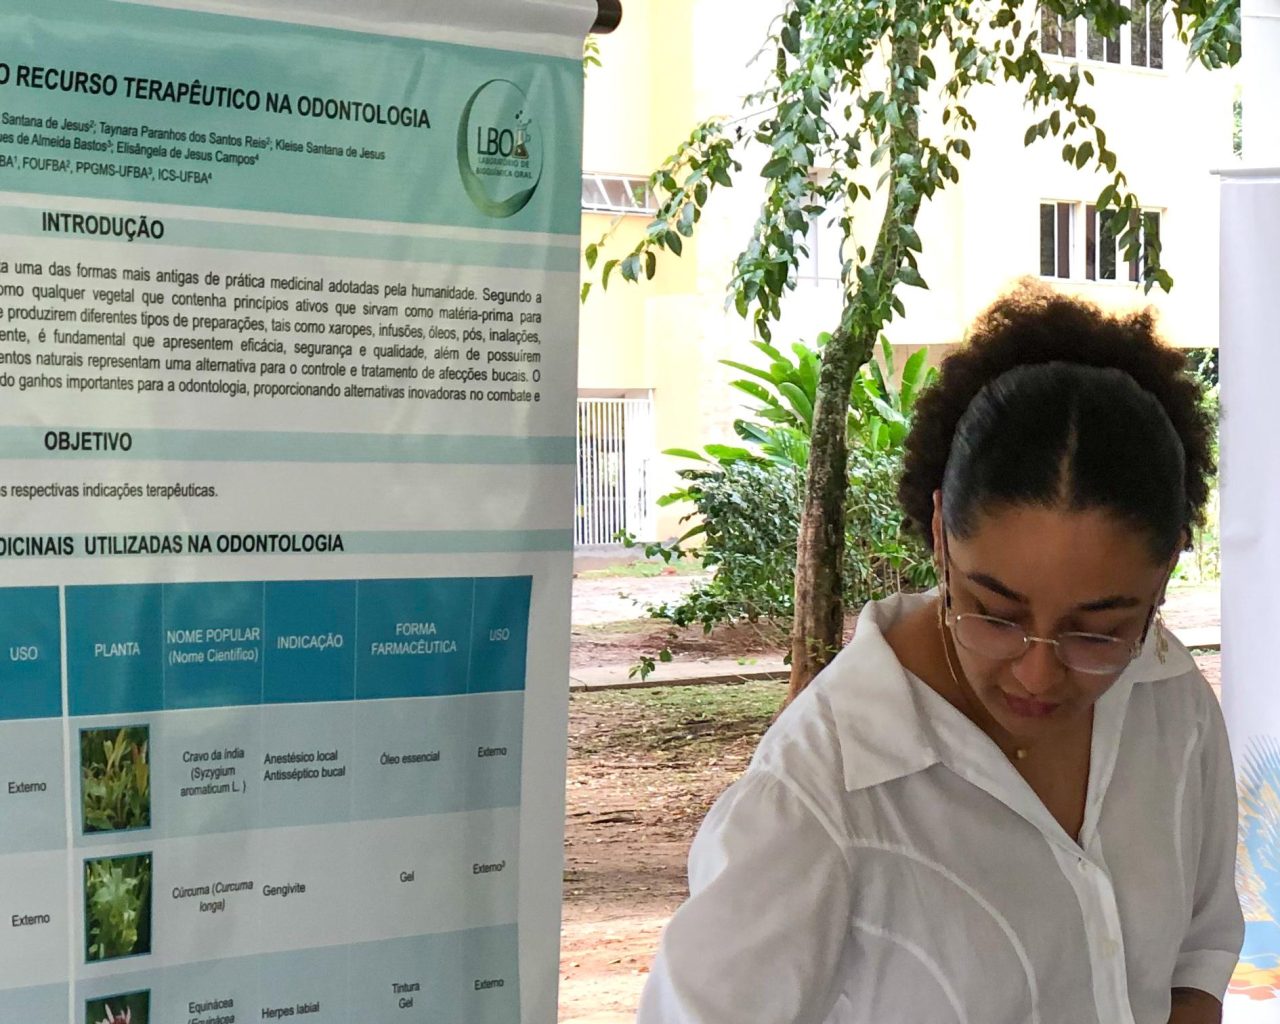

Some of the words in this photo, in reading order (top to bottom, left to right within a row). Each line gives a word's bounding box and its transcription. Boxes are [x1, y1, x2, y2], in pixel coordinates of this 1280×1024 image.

[16, 65, 117, 96] RECURSO
[124, 76, 260, 111] TERAPÊUTICO
[265, 92, 292, 114] NA
[297, 95, 431, 129] ODONTOLOGIA
[2, 112, 43, 129] Santana
[45, 116, 58, 129] de
[100, 121, 138, 137] Taynara
[140, 125, 187, 142] Paranhos
[188, 130, 206, 143] dos
[208, 132, 242, 147] Santos
[275, 138, 304, 152] Kleise
[306, 141, 344, 156] Santana
[345, 146, 357, 158] de
[359, 147, 385, 160] Jesus
[478, 126, 514, 157] LBO
[16, 132, 30, 145] de
[30, 133, 71, 149] Almeida
[116, 141, 167, 159] Elisângela
[169, 146, 182, 159] de
[184, 147, 213, 161] Jesus
[42, 212, 164, 242] INTRODUÇÃO
[14, 263, 42, 275] uma
[48, 261, 71, 277] das
[76, 262, 117, 279] formas
[122, 266, 150, 282] mais
[155, 269, 199, 287] antigas
[204, 271, 220, 286] de
[225, 273, 265, 289] prática
[270, 276, 323, 291] medicinal
[328, 279, 379, 295] adotadas
[384, 283, 406, 298] pela
[411, 283, 476, 300] humanidade.
[482, 287, 532, 305] Segundo
[535, 293, 542, 303] a
[31, 284, 85, 302] qualquer
[92, 288, 134, 305] vegetal
[141, 292, 164, 306] que
[171, 293, 227, 308] contenha
[234, 294, 289, 313] princípios
[295, 298, 328, 313] ativos
[334, 303, 356, 316] que
[362, 304, 398, 316] sirvam
[404, 306, 434, 318] como
[439, 306, 514, 324] matéria-prima
[520, 312, 542, 325] para
[7, 305, 76, 322] produzirem
[80, 308, 137, 325] diferentes
[140, 311, 169, 328] tipos
[172, 312, 188, 327] de
[192, 316, 267, 333] preparações,
[271, 318, 291, 332] tais
[294, 321, 326, 334] como
[328, 323, 375, 338] xaropes,
[378, 322, 425, 339] infusões,
[428, 325, 459, 341] óleos,
[462, 327, 485, 343] pós,
[489, 327, 540, 345] inalações,
[44, 431, 132, 451] OBJETIVO
[10, 482, 79, 500] respectivas
[82, 482, 143, 500] indicações
[146, 482, 218, 500] terapêuticas.
[85, 535, 182, 555] UTILIZADAS
[188, 534, 212, 552] NA
[216, 534, 344, 553] ODONTOLOGIA
[167, 629, 202, 643] NOME
[206, 627, 260, 642] POPULAR
[396, 622, 437, 635] FORMA
[489, 627, 510, 641] USO
[94, 642, 140, 657] PLANTA
[277, 632, 343, 651] INDICAÇÃO
[371, 638, 457, 655] FARMACÊUTICA
[10, 646, 38, 661] USO
[168, 650, 204, 665] (Nome
[206, 647, 258, 662] Científico)
[182, 751, 209, 763] Cravo
[210, 749, 222, 761] da
[224, 748, 244, 759] índia
[263, 751, 314, 764] Anestésico
[316, 749, 338, 761] local
[380, 751, 400, 765] Óleo
[401, 750, 440, 764] essencial
[477, 746, 507, 757] Externo
[191, 766, 235, 781] (Syzygium
[263, 768, 319, 781] Antisséptico
[321, 765, 346, 777] bucal
[8, 781, 47, 794] Externo
[180, 783, 230, 797] aromaticum
[399, 871, 414, 882] Gel
[172, 885, 210, 899] Cúrcuma
[211, 880, 254, 896] (Curcuma
[262, 883, 306, 897] Gengivite
[11, 914, 50, 927] Externo
[391, 982, 420, 993] Tintura
[474, 978, 504, 990] Externo
[261, 1006, 294, 1019] Herpes
[296, 1001, 319, 1014] labial
